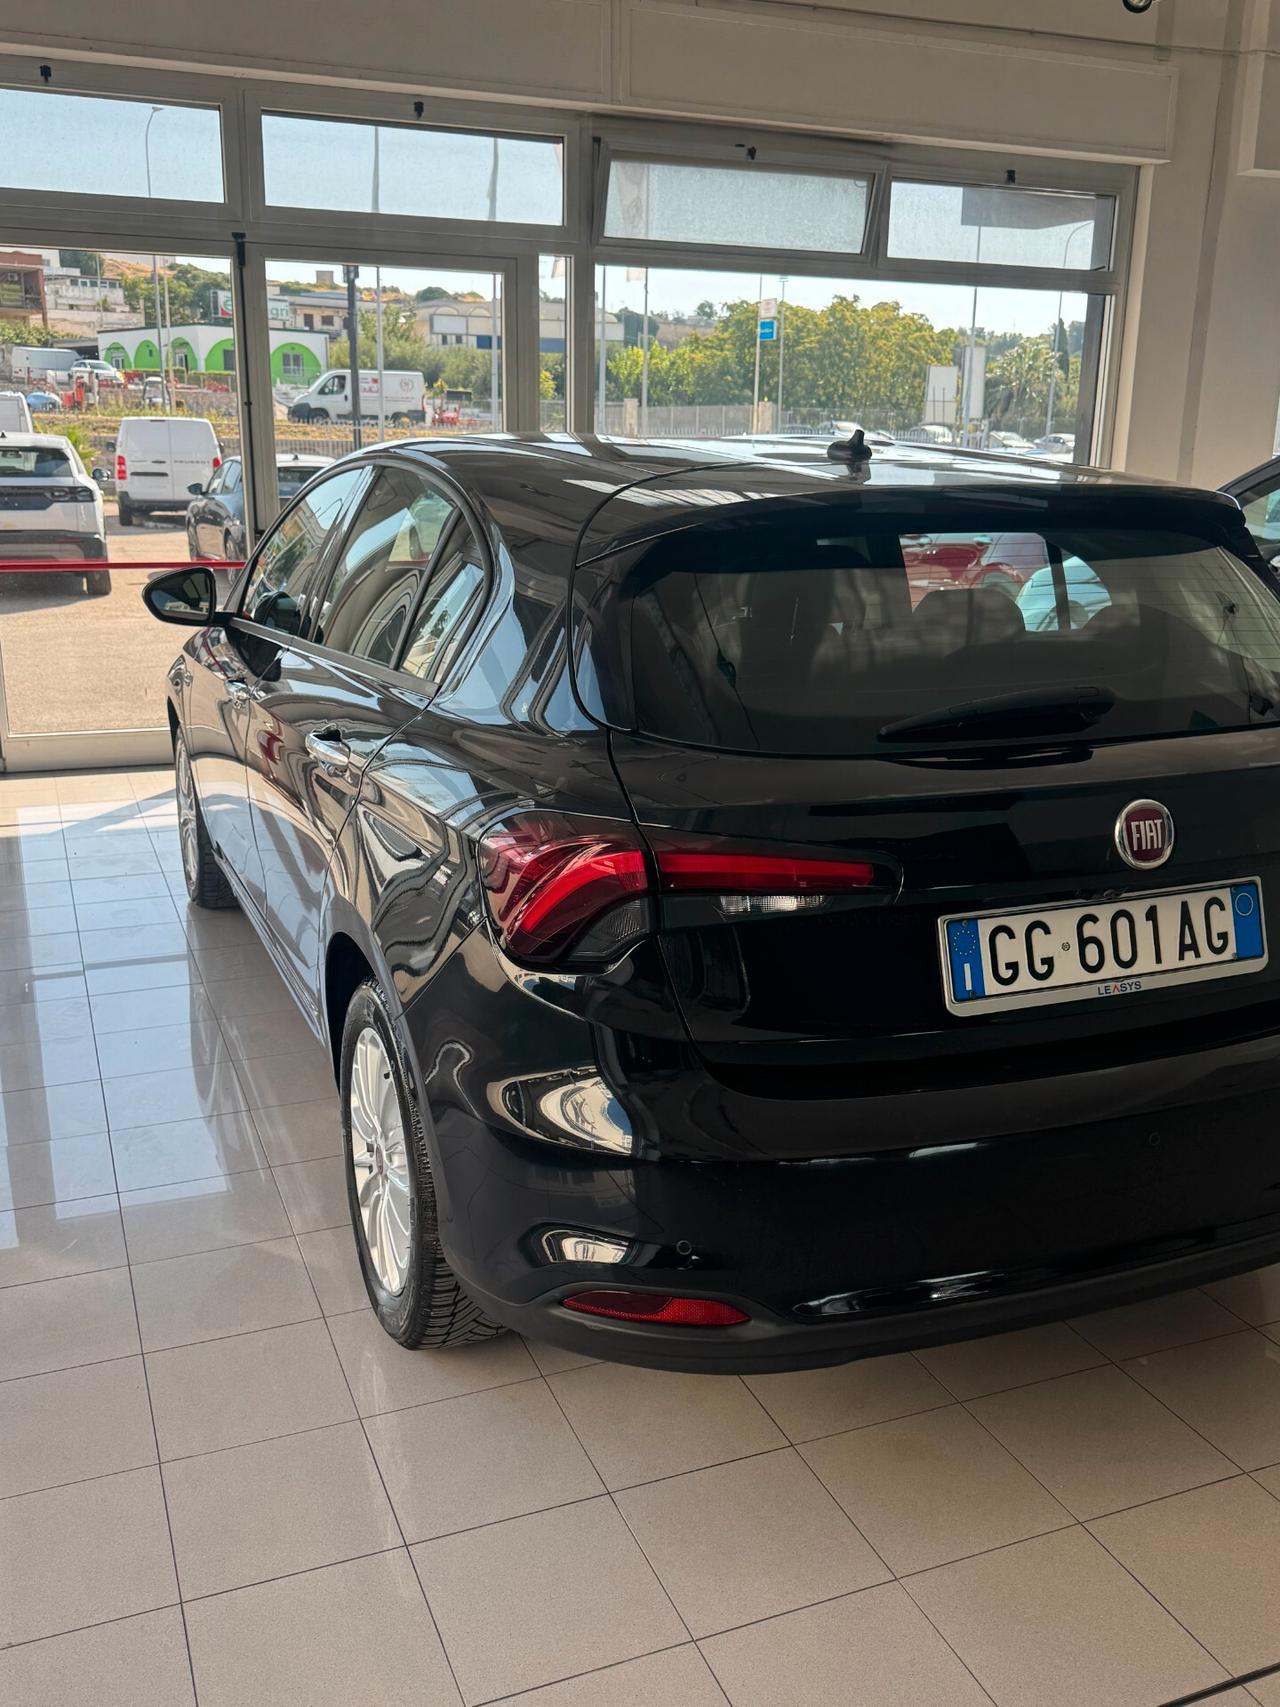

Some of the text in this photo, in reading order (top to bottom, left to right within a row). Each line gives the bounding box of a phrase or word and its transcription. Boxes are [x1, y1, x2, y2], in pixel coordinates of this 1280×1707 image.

[1131, 820, 1163, 851] FIAT
[988, 920, 1054, 986] GG
[1097, 981, 1142, 996] LEASYS
